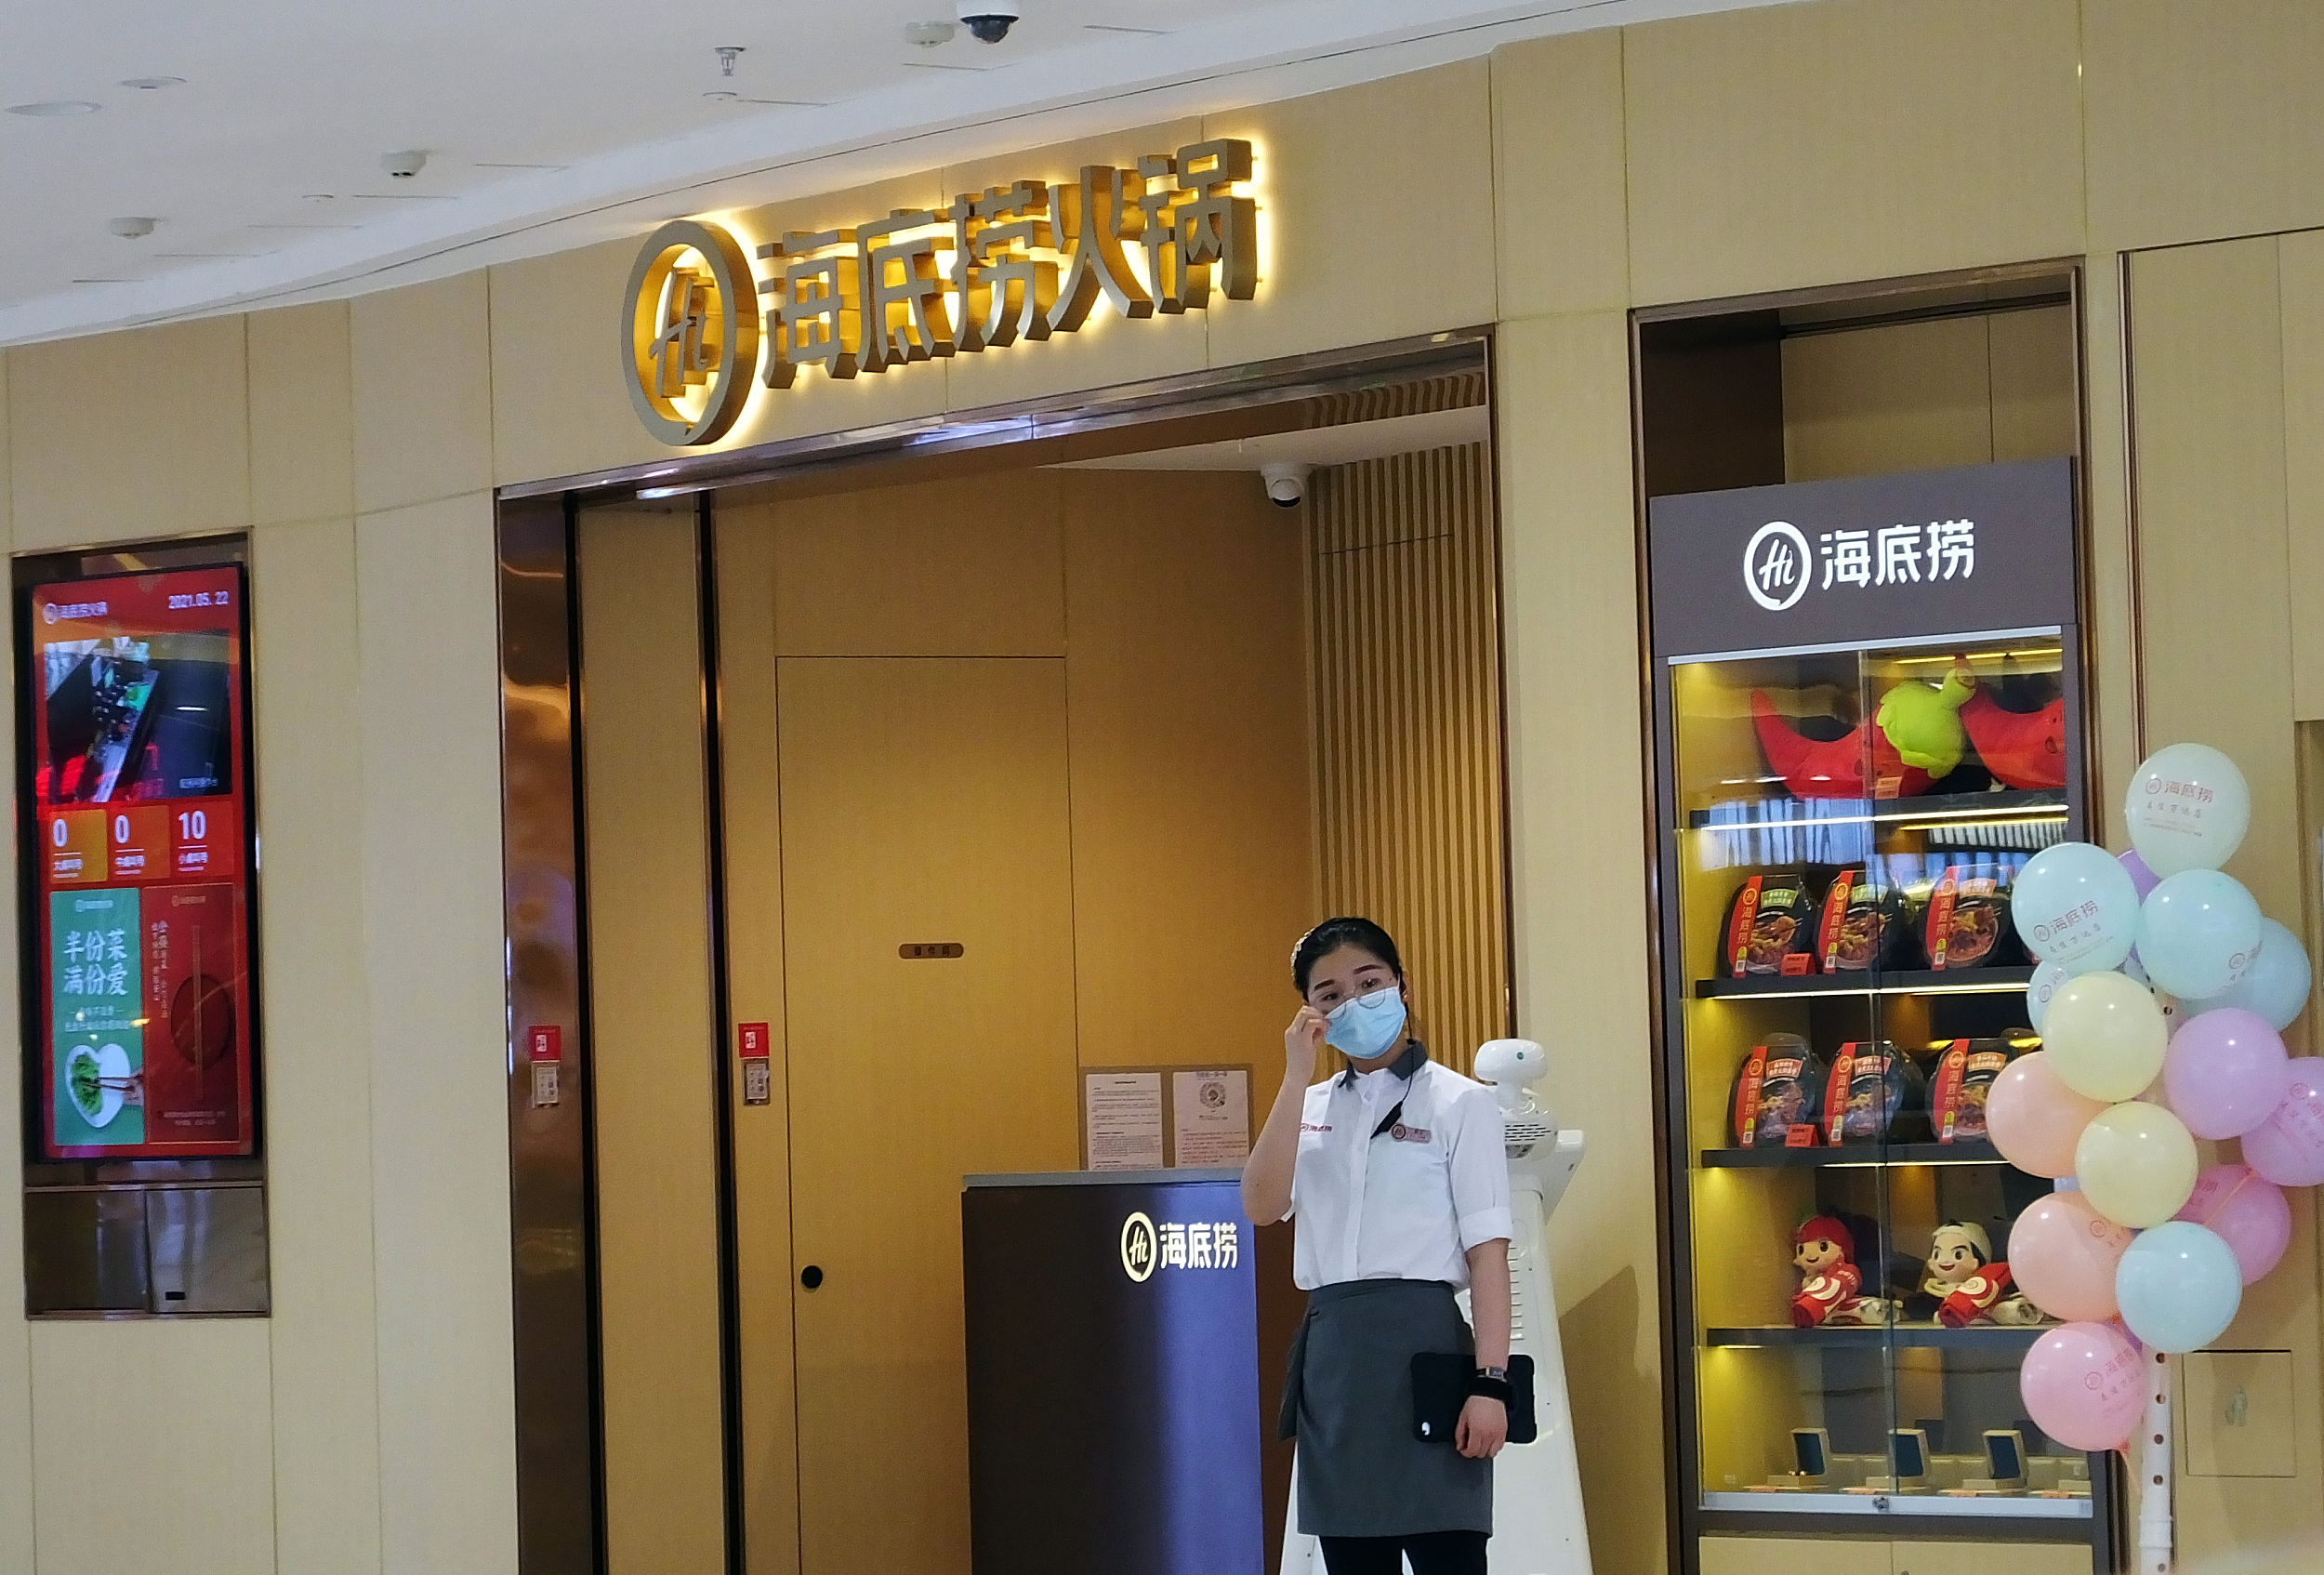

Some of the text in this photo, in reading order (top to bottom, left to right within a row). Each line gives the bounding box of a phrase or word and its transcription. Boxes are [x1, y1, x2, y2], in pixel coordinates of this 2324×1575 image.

[756, 138, 1257, 389] 海底捞火锅
[1819, 519, 1974, 590] 海底捞
[53, 818, 68, 847] 0
[114, 814, 130, 844] 0
[178, 810, 207, 840] 10
[1158, 1222, 1238, 1269] 海底捞
